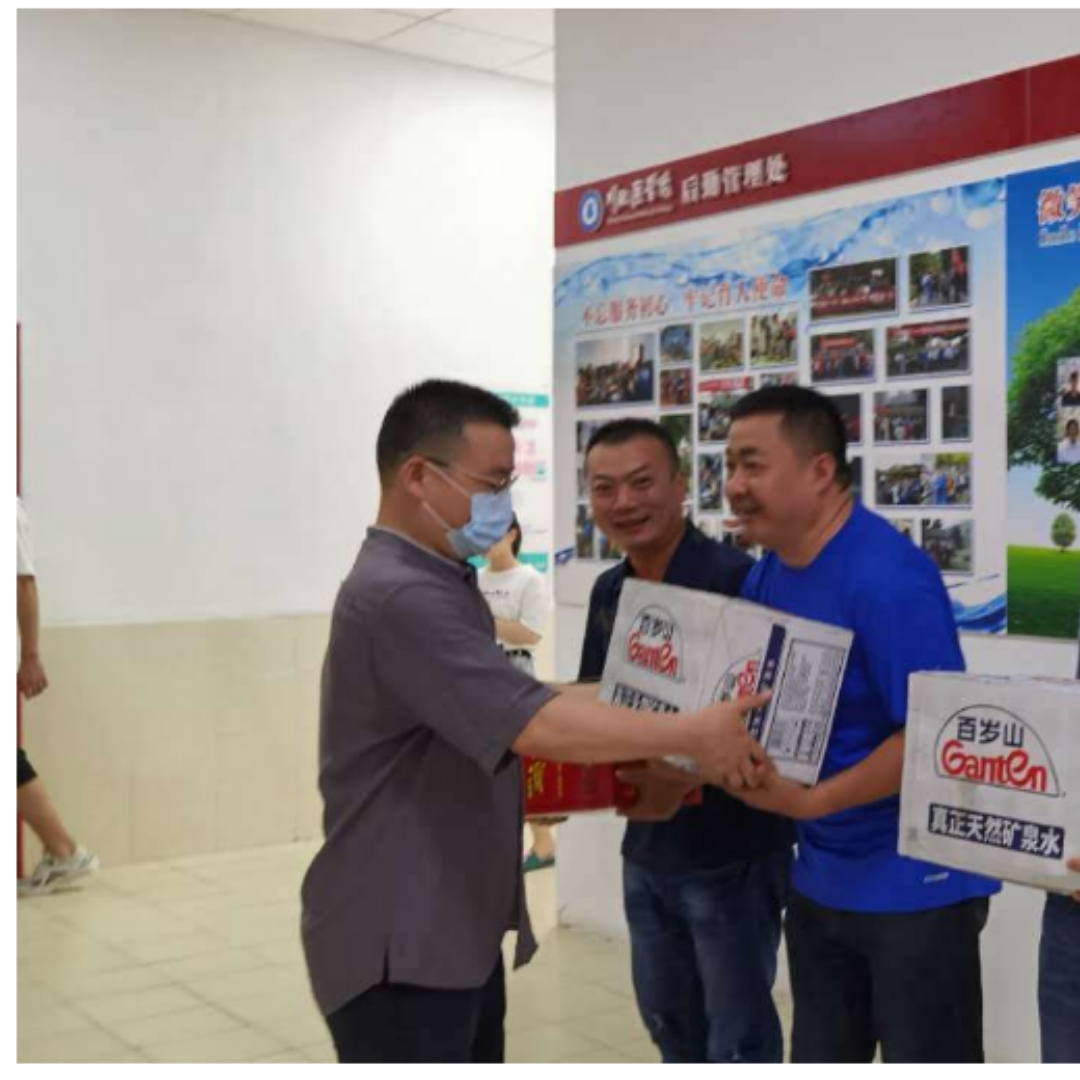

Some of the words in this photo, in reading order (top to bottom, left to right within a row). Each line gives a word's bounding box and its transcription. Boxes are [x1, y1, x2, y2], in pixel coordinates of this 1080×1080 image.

[680, 153, 788, 205] 后勤管理处
[956, 716, 1025, 748] 百岁山
[941, 739, 1047, 793] Ganten
[930, 806, 1062, 856] 真正天然矿泉水
